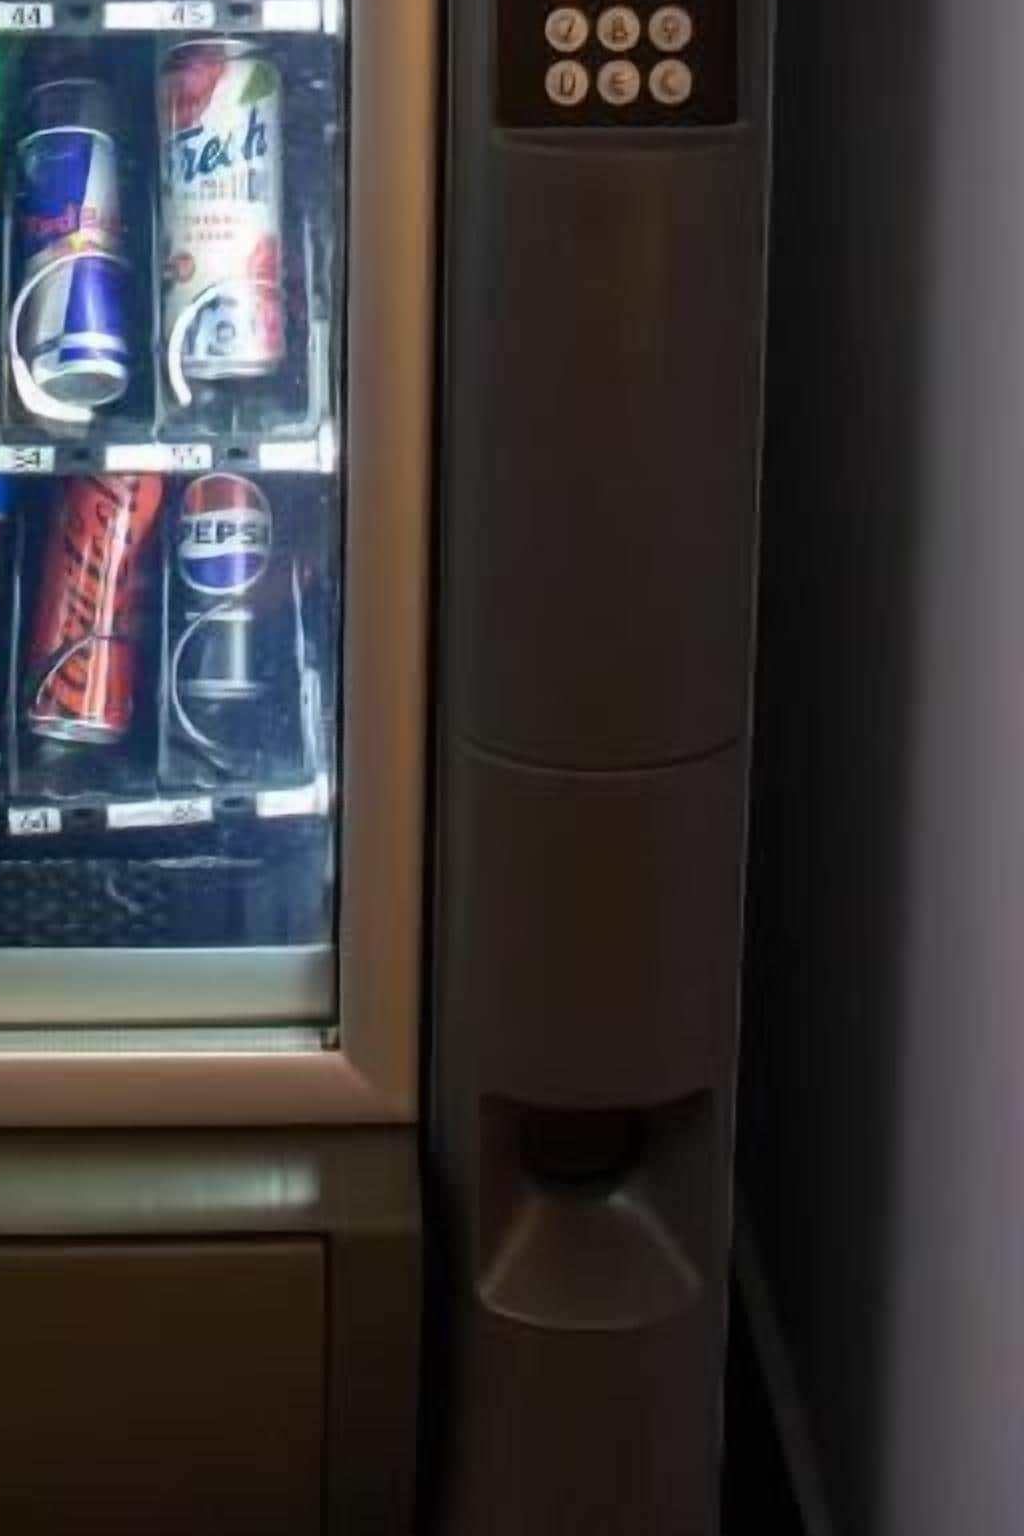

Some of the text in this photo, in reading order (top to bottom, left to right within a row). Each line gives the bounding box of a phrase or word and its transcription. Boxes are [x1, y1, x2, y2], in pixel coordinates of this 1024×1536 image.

[10, 3, 41, 25] 44
[556, 16, 576, 42] 7
[611, 15, 628, 43] 8
[183, 520, 269, 545] PEPSI
